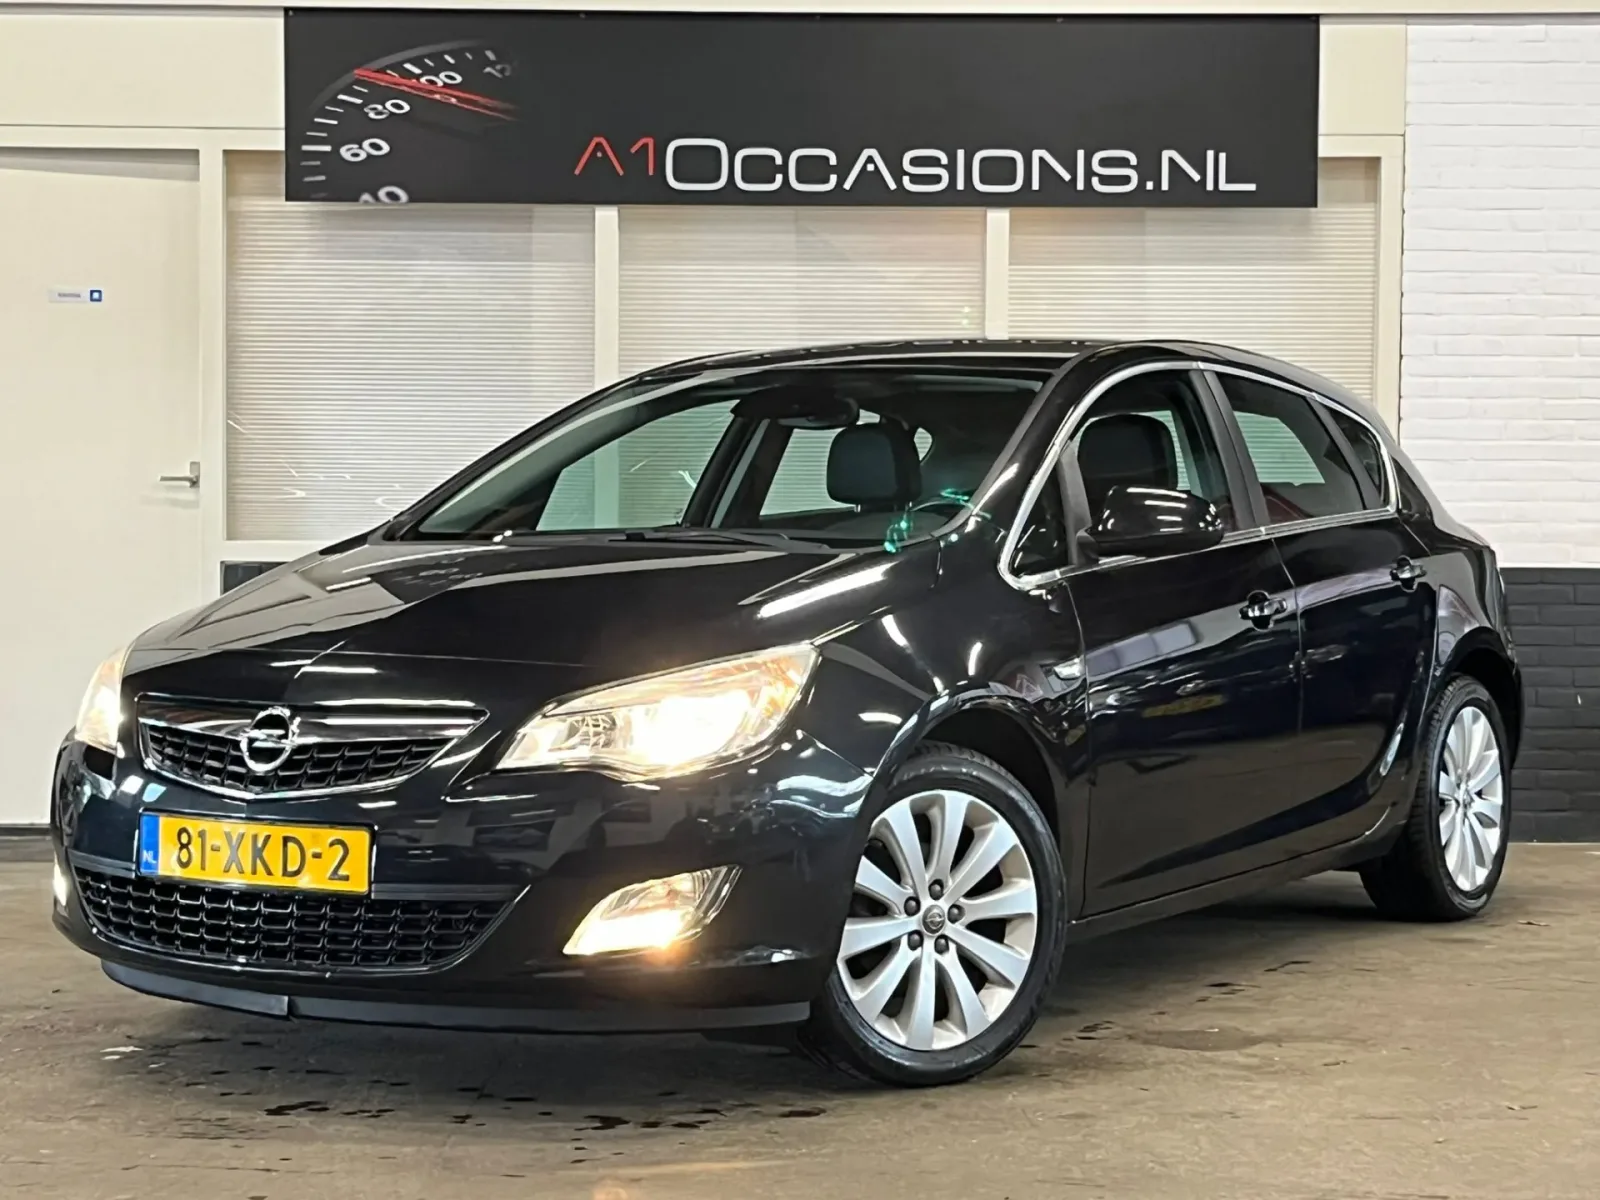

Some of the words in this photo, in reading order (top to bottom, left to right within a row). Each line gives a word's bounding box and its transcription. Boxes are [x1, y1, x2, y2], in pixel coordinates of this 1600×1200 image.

[363, 99, 411, 120] 80
[339, 138, 391, 162] 60
[143, 849, 157, 864] NL
[176, 826, 350, 882] 81-XKD-2
